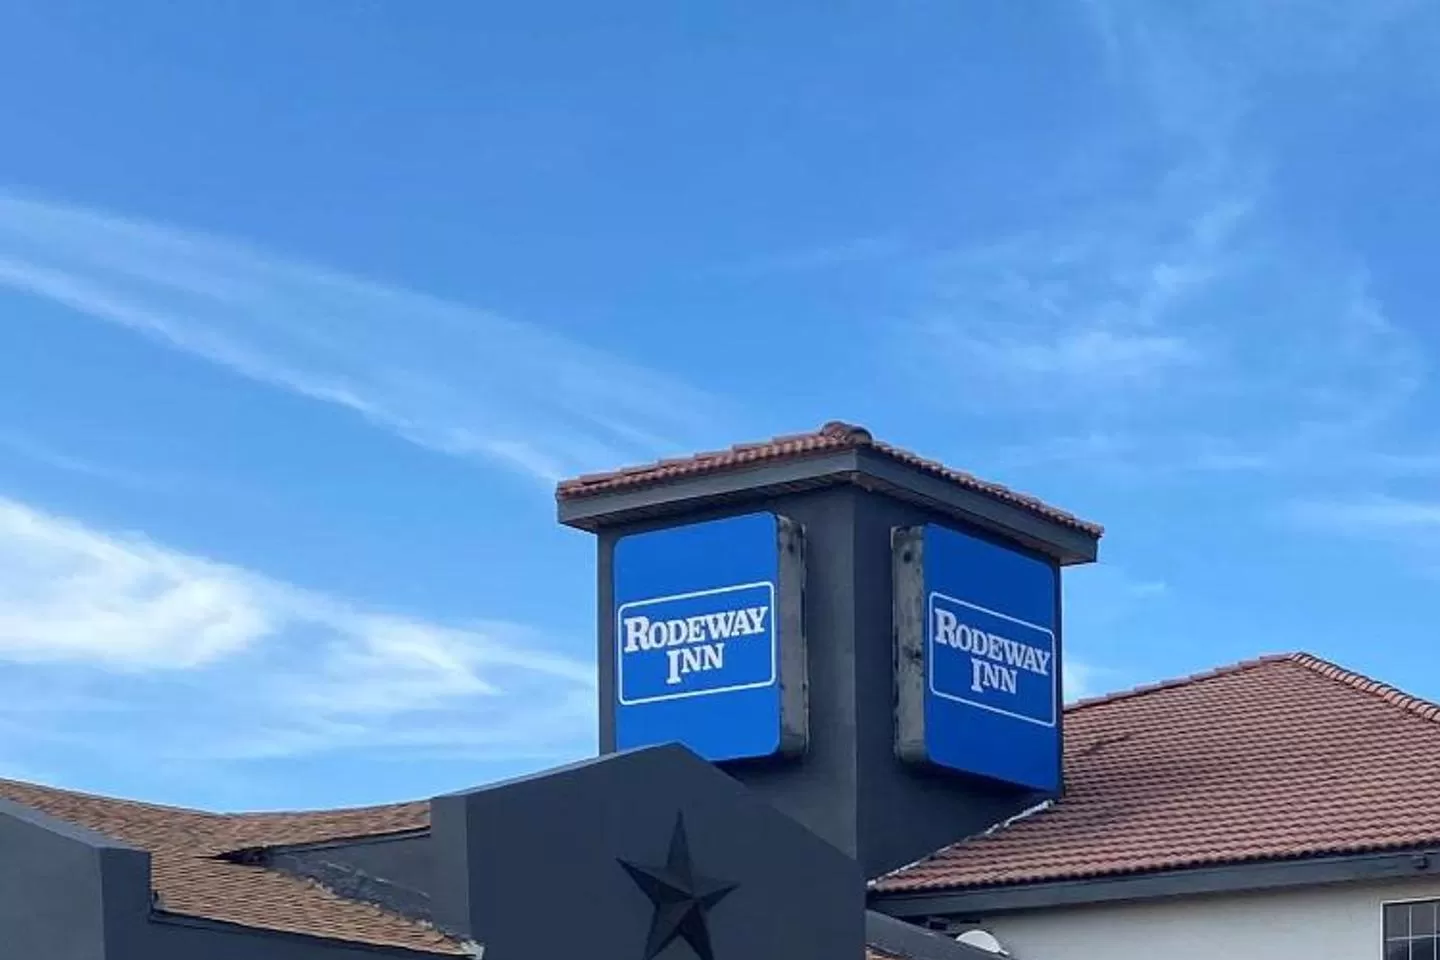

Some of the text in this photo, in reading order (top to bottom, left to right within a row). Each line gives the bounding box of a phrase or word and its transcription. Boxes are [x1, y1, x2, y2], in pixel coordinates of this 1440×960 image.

[624, 606, 768, 653] RODEWAY
[935, 608, 1050, 676] RODEWAY
[666, 643, 724, 684] INN
[971, 658, 1017, 694] INN
